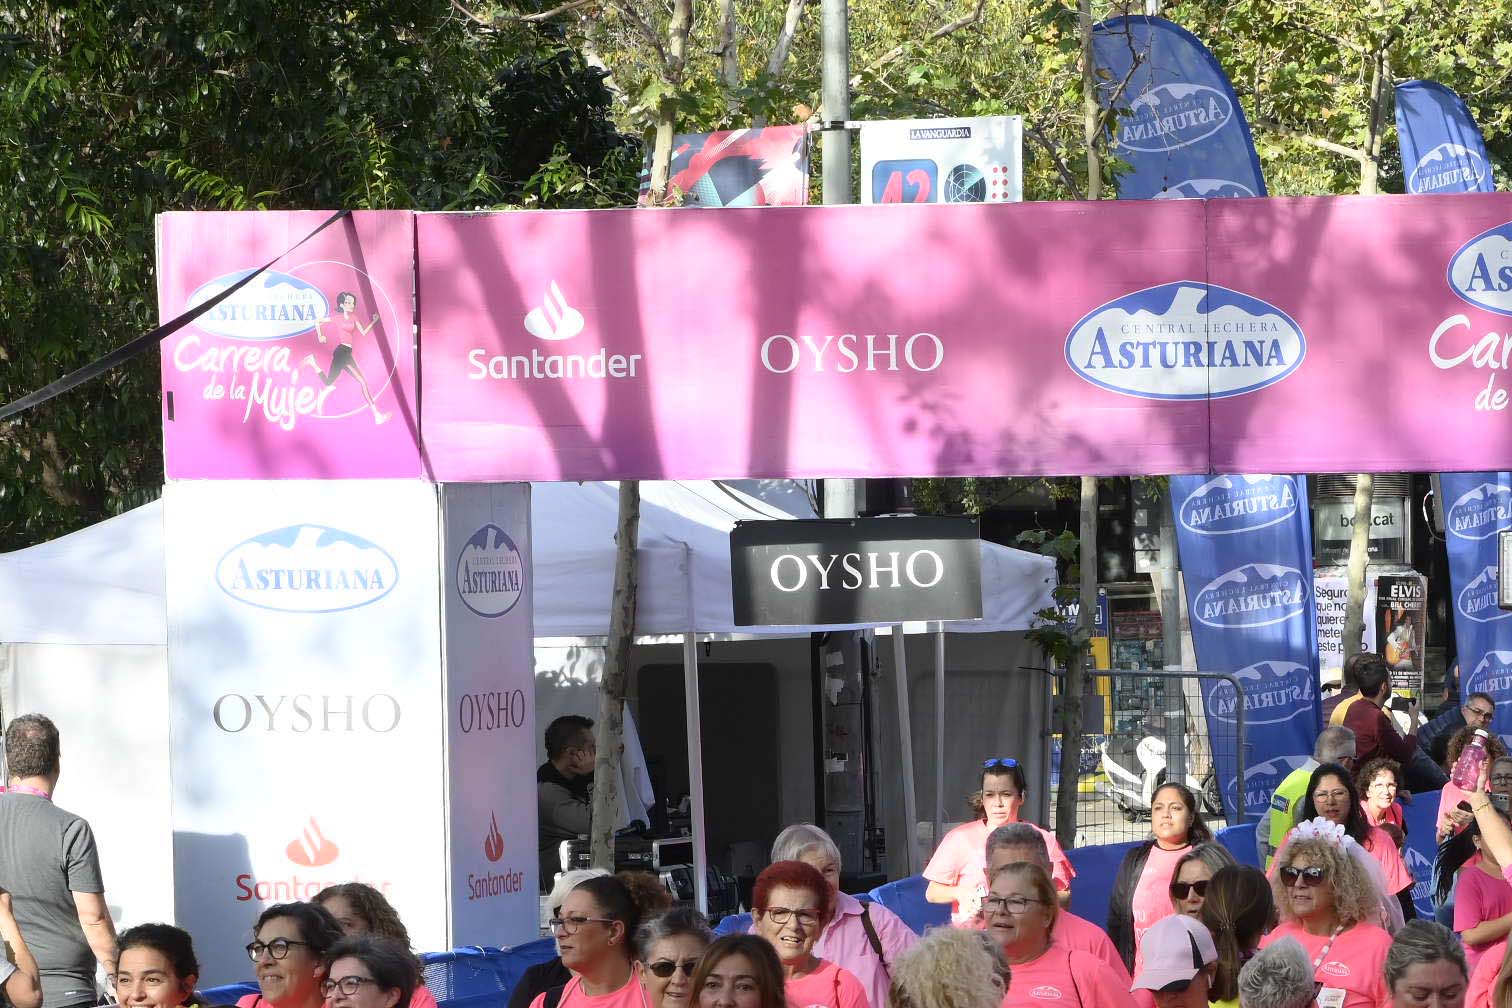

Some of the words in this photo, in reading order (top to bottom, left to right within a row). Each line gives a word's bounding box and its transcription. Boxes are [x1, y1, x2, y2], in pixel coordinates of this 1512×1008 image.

[209, 302, 317, 322] STURIANA
[1120, 323, 1197, 335] CENTRAL
[1203, 321, 1279, 333] LECHERA
[174, 335, 292, 373] Carrera
[468, 347, 642, 379] Santander
[760, 332, 944, 374] OYSHO
[1083, 326, 1288, 370] ASTURIANA
[203, 372, 226, 401] de
[230, 373, 247, 401] la
[243, 367, 337, 431] Mujer
[1474, 372, 1510, 411] de
[232, 557, 386, 591] ASTURIANA
[462, 559, 520, 594] ASTURIANA
[769, 550, 945, 592] OYSHO
[1316, 603, 1332, 614] que
[1390, 585, 1421, 598] ELVIS
[1318, 641, 1337, 652] este
[212, 693, 402, 733] OYSHO
[459, 689, 526, 733] OYSHO
[467, 870, 525, 901] Santander
